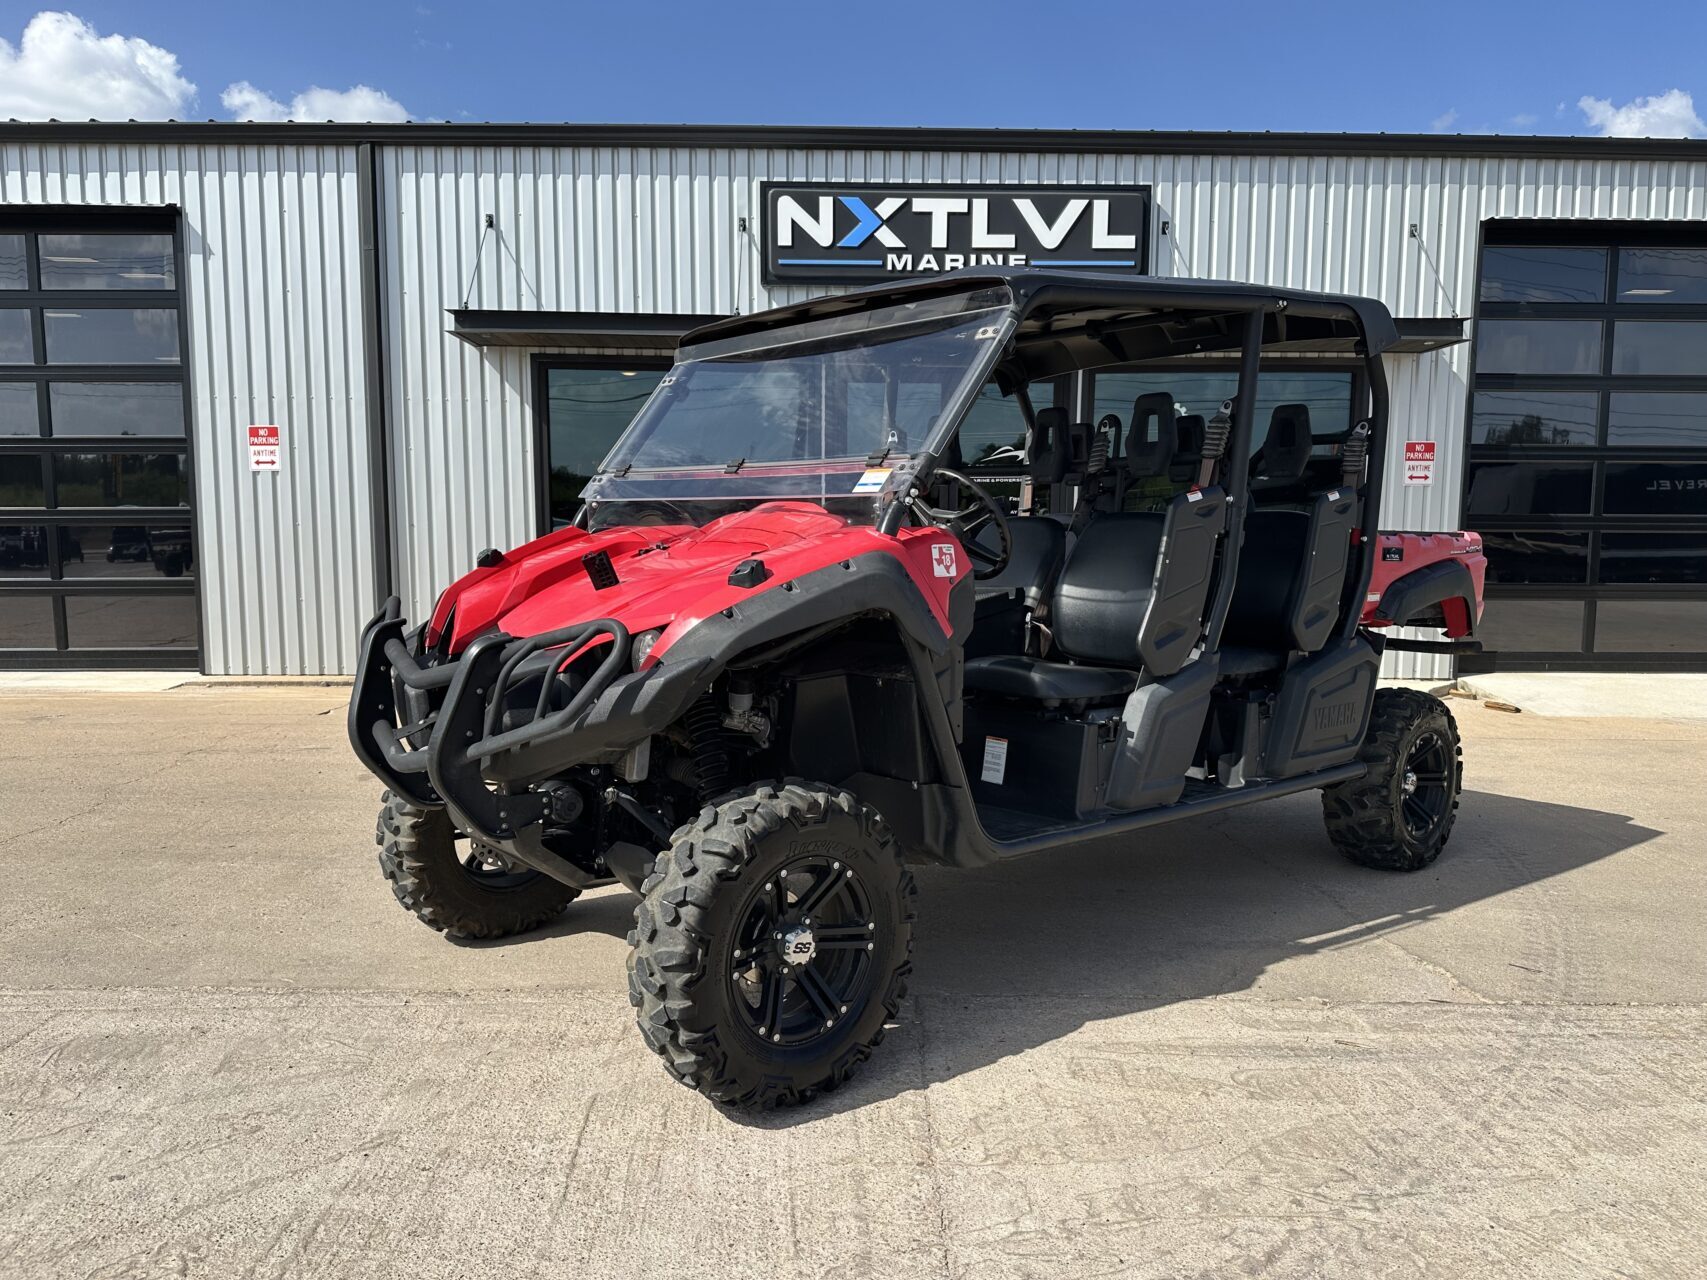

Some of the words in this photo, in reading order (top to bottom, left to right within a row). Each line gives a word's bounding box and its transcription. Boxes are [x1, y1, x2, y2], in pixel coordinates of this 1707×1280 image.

[777, 195, 1136, 249] NXTLVL
[887, 254, 1026, 271] MARINE
[258, 428, 268, 436] NO
[942, 554, 951, 566] 18
[1314, 702, 1358, 731] YAMAHA
[793, 942, 812, 953] SS
